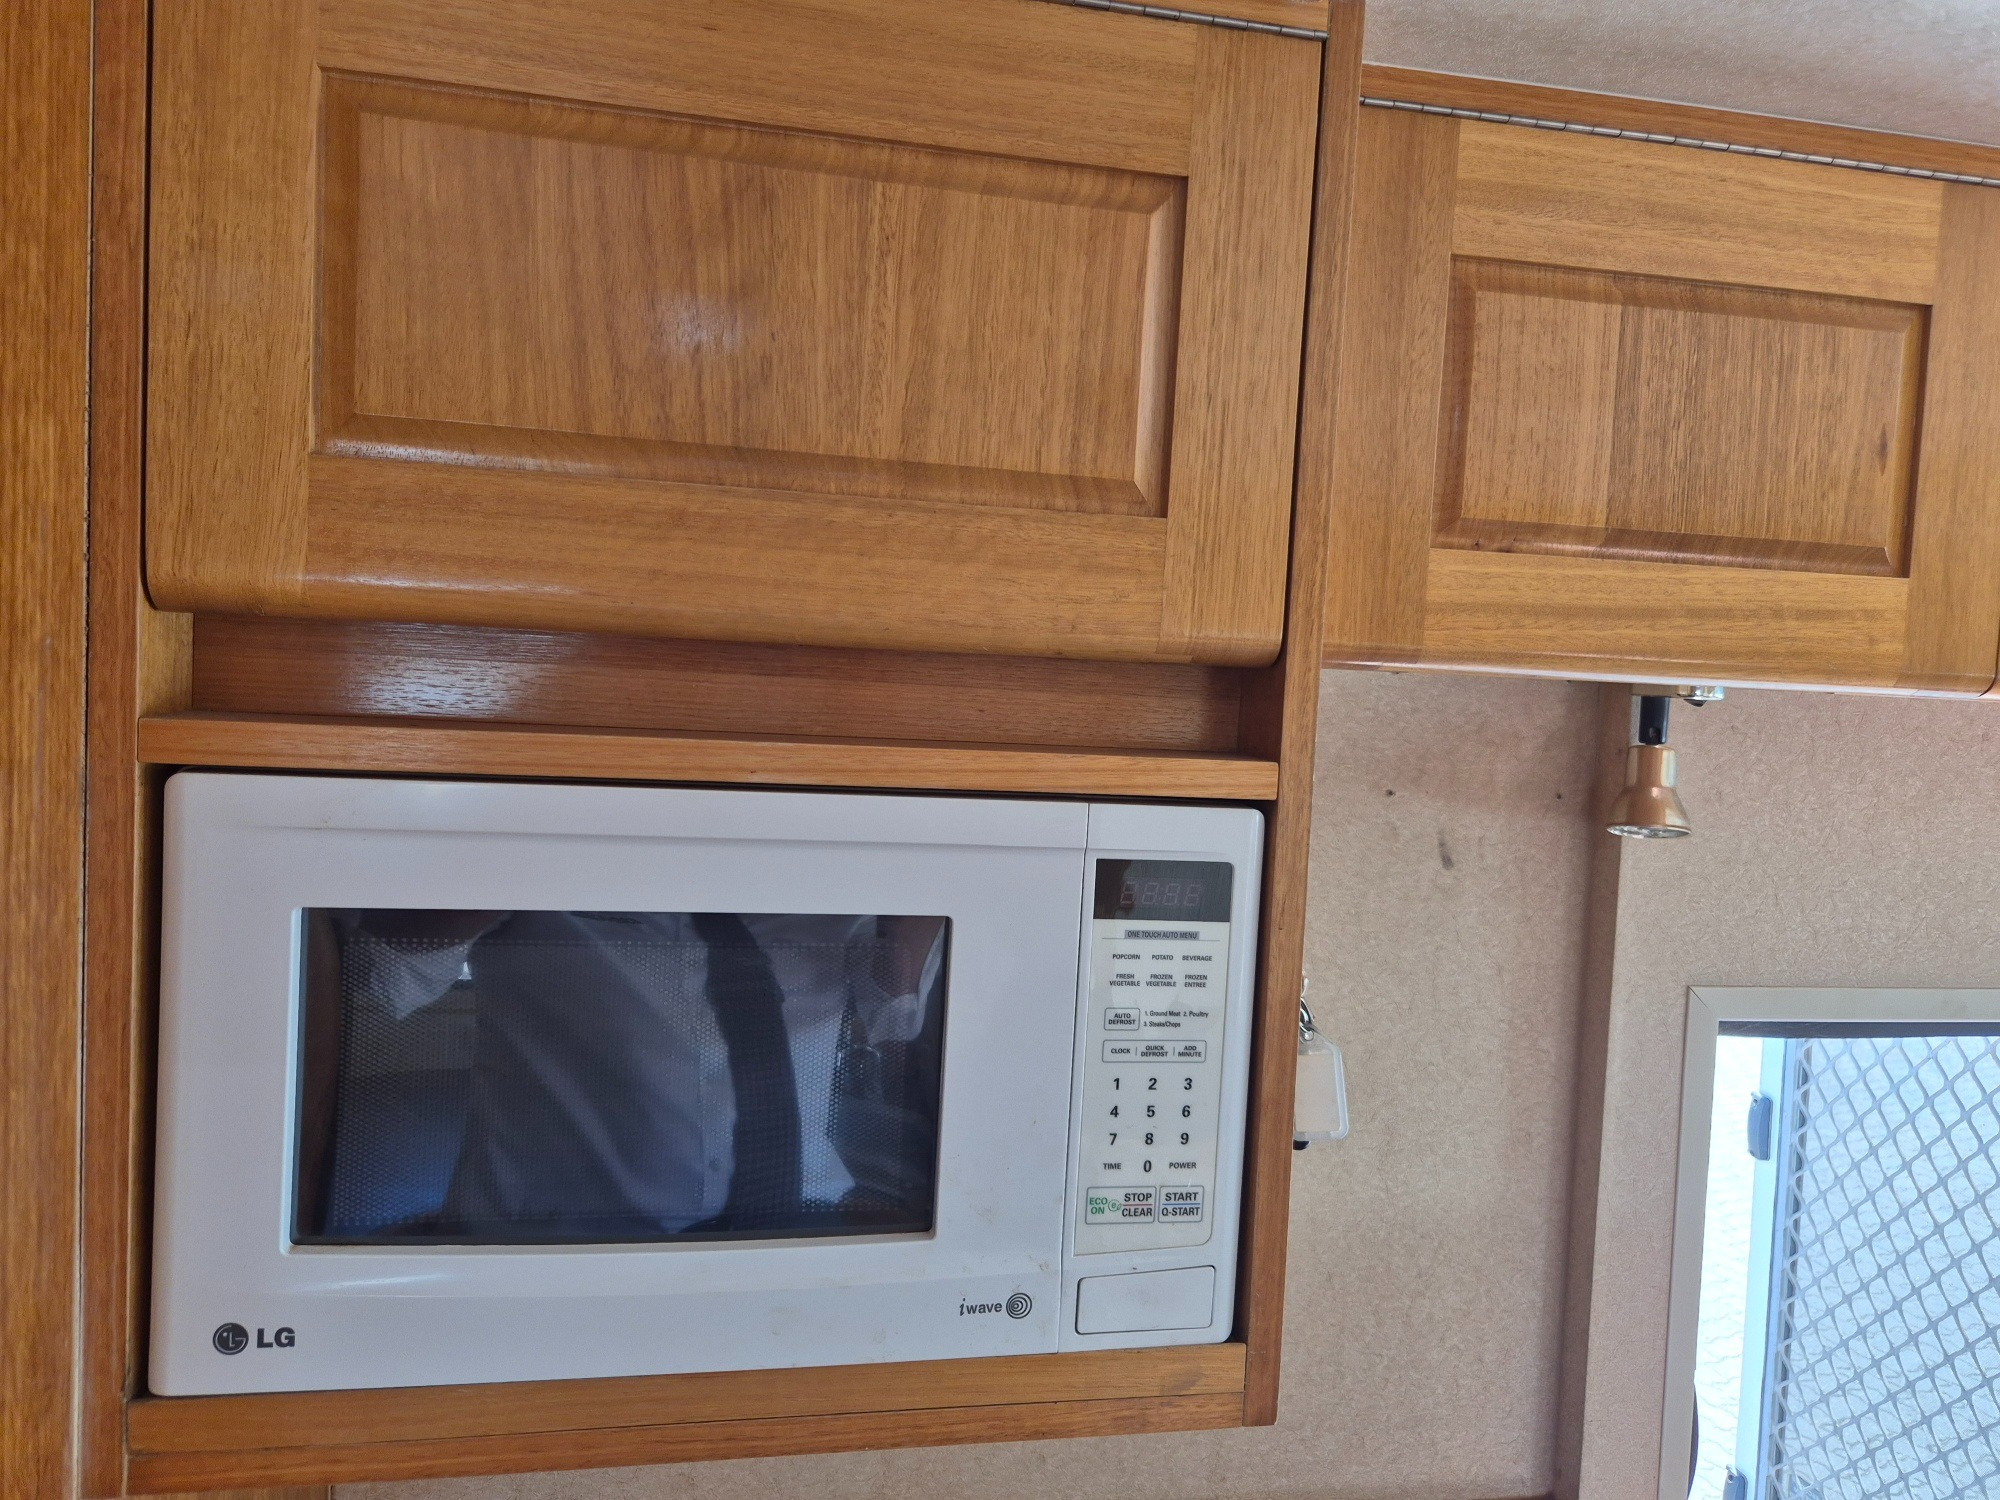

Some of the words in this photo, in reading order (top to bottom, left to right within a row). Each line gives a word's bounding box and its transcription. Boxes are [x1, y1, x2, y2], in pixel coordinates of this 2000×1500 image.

[1113, 1078, 1120, 1090] 1
[1148, 1078, 1157, 1090] 2
[1184, 1078, 1193, 1090] 3
[1110, 1106, 1119, 1117] 4
[1146, 1106, 1155, 1117] 5
[1182, 1105, 1190, 1118] 6
[1109, 1133, 1117, 1145] 7
[1144, 1133, 1154, 1145] 8
[1180, 1133, 1189, 1145] 9
[1143, 1160, 1152, 1172] 0
[1089, 1197, 1108, 1205] ECO
[1124, 1193, 1152, 1202] STOP
[1165, 1192, 1199, 1201] START
[1122, 1208, 1153, 1217] CLEAR
[1161, 1207, 1200, 1216] Q-START
[257, 1327, 295, 1348] LG
